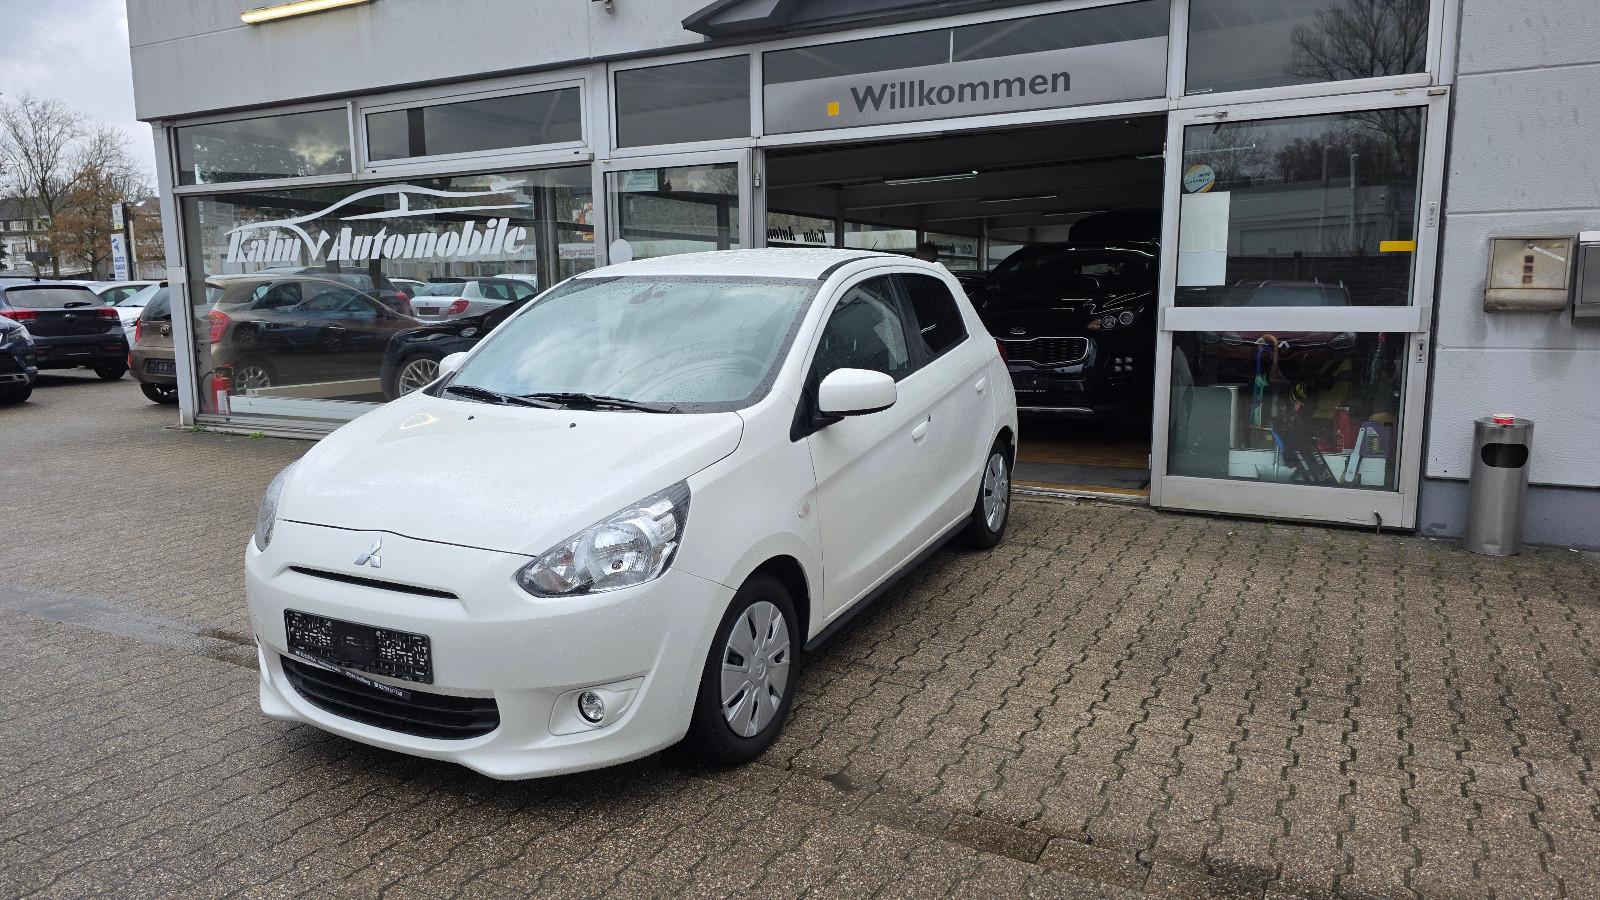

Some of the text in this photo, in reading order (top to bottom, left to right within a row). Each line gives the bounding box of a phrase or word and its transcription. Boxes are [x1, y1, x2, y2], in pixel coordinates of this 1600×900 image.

[850, 71, 1071, 113] Willkommen
[226, 217, 527, 263] Kahn Automobile
